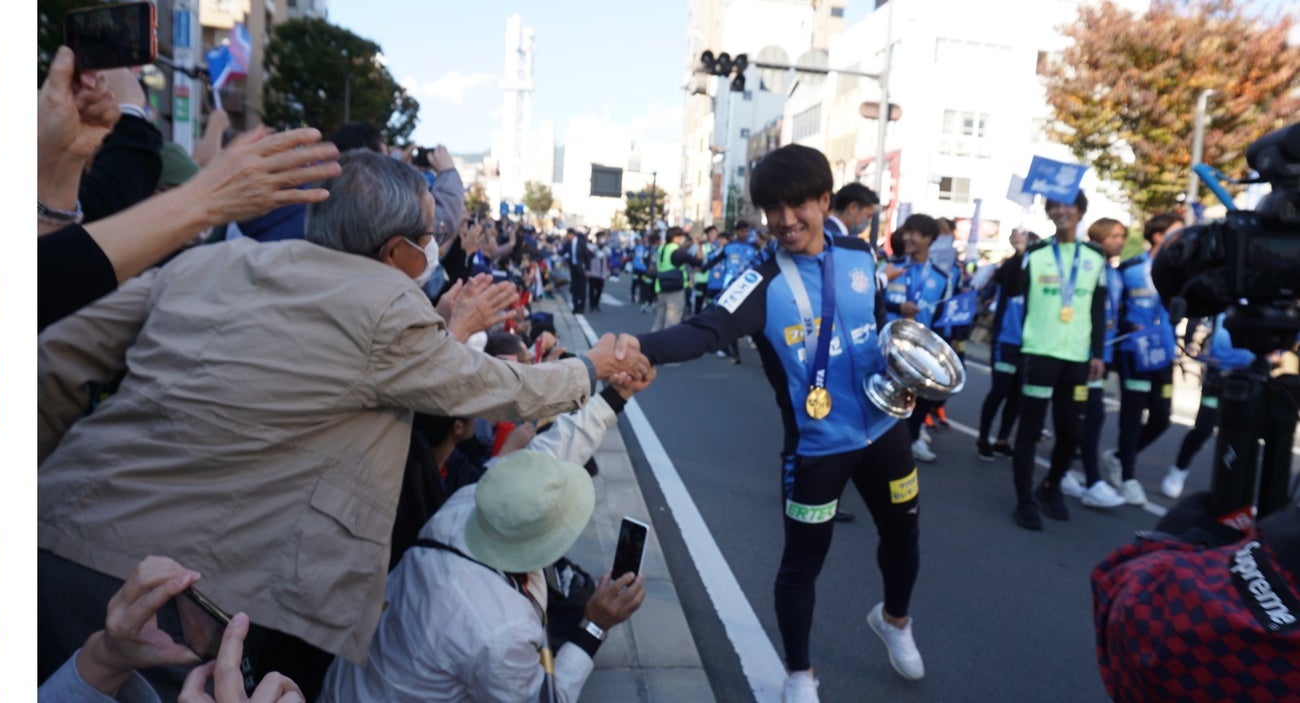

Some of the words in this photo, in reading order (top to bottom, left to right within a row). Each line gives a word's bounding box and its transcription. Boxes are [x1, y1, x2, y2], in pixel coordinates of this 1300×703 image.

[804, 317, 813, 337] JFA
[815, 369, 826, 389] JFA
[1230, 541, 1297, 625] Supreme
